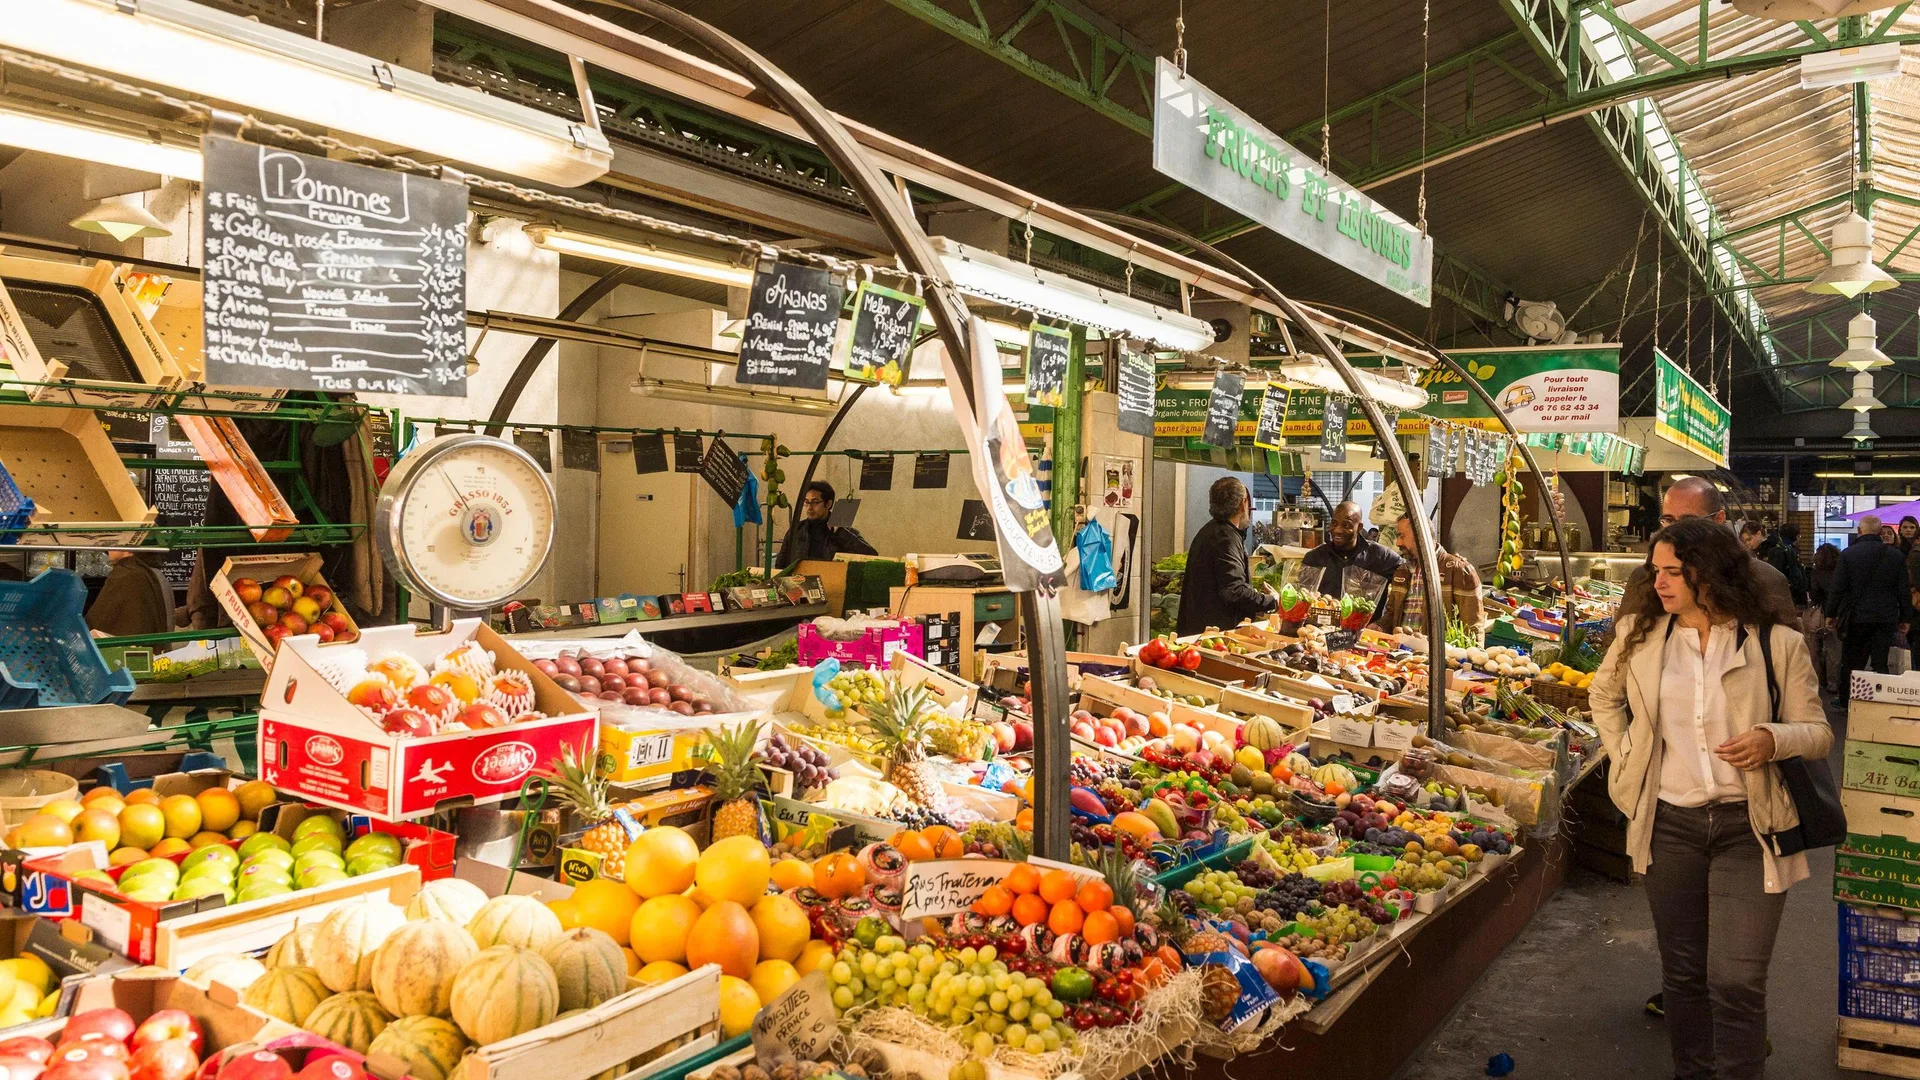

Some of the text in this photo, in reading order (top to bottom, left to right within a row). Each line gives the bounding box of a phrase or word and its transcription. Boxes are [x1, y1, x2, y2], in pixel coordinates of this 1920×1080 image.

[262, 152, 391, 216] Pommes
[1205, 105, 1412, 270] FRUITS ET LEGUMES
[226, 193, 257, 216] Fuji
[308, 205, 364, 228] France
[225, 212, 293, 248] Golden
[216, 254, 260, 284] Pink
[219, 279, 264, 299] Jazz
[765, 273, 828, 311] Ananas
[305, 304, 347, 318] France
[864, 294, 890, 315] Melon
[219, 312, 270, 335] Granny
[311, 375, 352, 390] Tous
[1189, 399, 1208, 407] FRO
[1300, 397, 1321, 405] FINE
[1335, 397, 1356, 405] PRO
[1544, 395, 1577, 403] appeler
[1285, 423, 1315, 431] samedi
[1351, 422, 1367, 430] 20h
[1398, 421, 1430, 430] manche
[449, 489, 513, 517] GRASSO 1854
[225, 589, 250, 628] FRUITS
[1887, 686, 1920, 695] BLUEBE
[311, 741, 340, 762] Sweet
[482, 748, 532, 776] Sweet
[424, 786, 447, 797] BY AIR
[1895, 776, 1920, 789] Ba
[779, 808, 794, 822] Ets
[1860, 890, 1920, 907] COBRA
[776, 1008, 810, 1041] FRANCE
